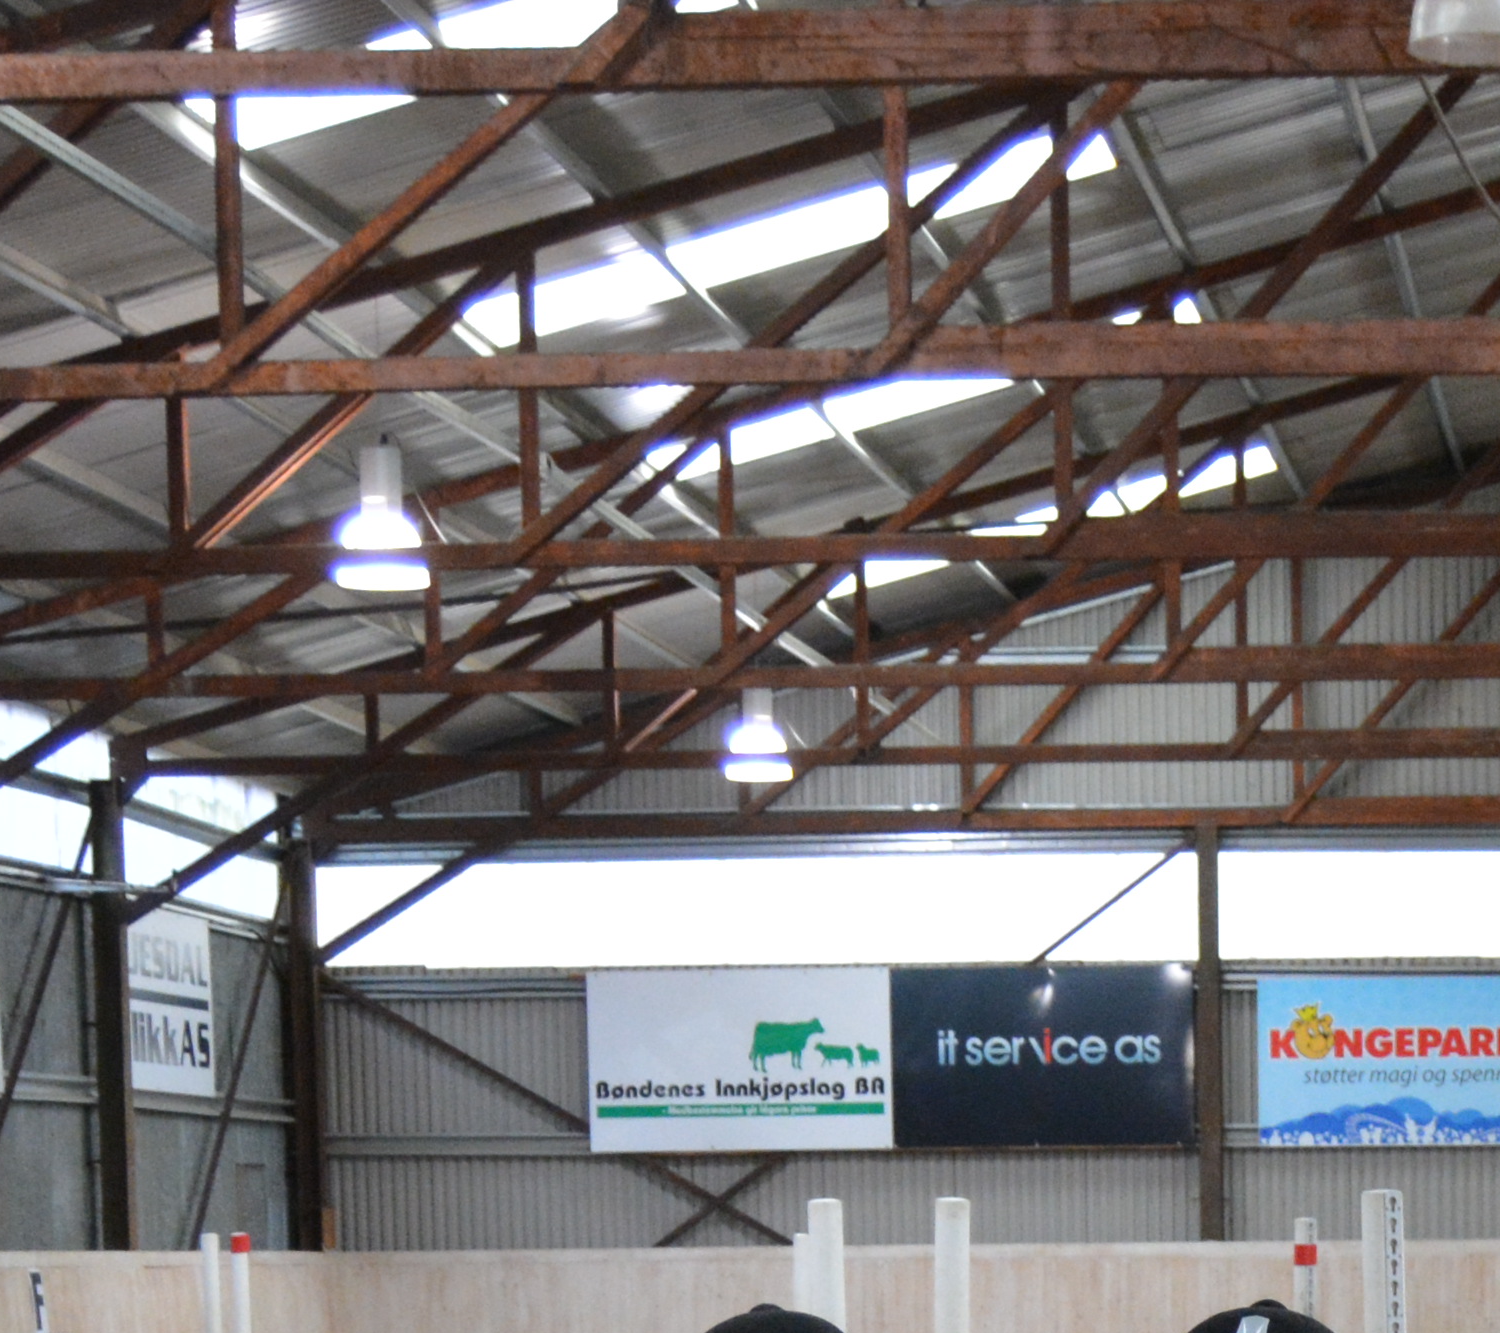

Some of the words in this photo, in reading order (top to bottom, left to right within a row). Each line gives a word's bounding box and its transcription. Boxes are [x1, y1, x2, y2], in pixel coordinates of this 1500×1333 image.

[937, 1029, 958, 1065] it
[965, 1027, 1107, 1066] service
[1115, 1034, 1162, 1064] as
[1304, 1065, 1365, 1084] støtter
[1369, 1064, 1417, 1087] magi
[1422, 1067, 1446, 1087] og
[596, 1080, 706, 1100] Bøndenes
[714, 1077, 845, 1100] Innkjøpslag
